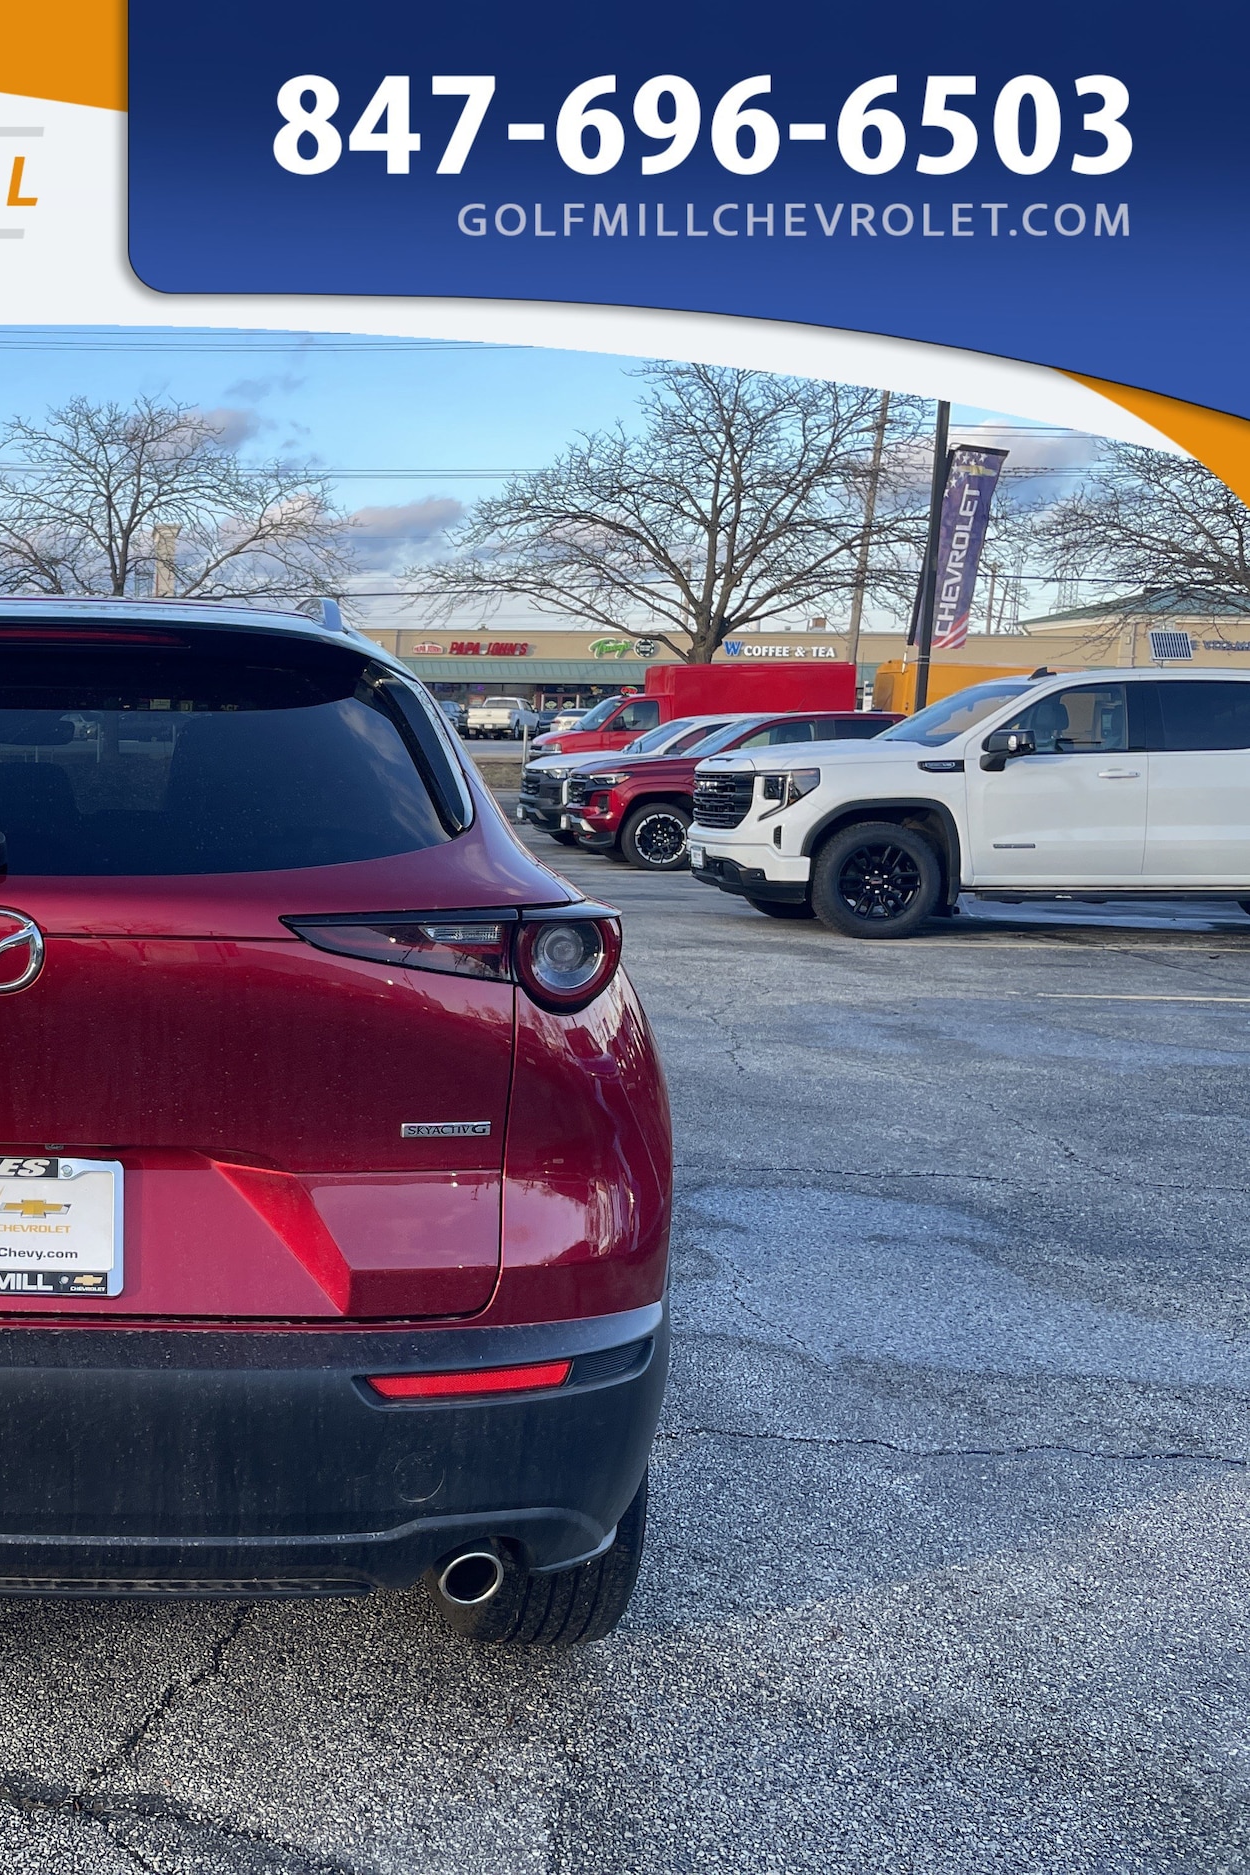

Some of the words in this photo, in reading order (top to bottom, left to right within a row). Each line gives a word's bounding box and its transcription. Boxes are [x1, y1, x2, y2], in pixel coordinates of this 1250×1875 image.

[935, 483, 981, 637] CHEVROLET
[449, 641, 481, 656] PAPA
[485, 642, 529, 656] JOHN'S
[723, 641, 743, 657] W
[743, 645, 790, 658] COFFEE
[794, 645, 806, 658] &
[811, 646, 836, 658] TEA
